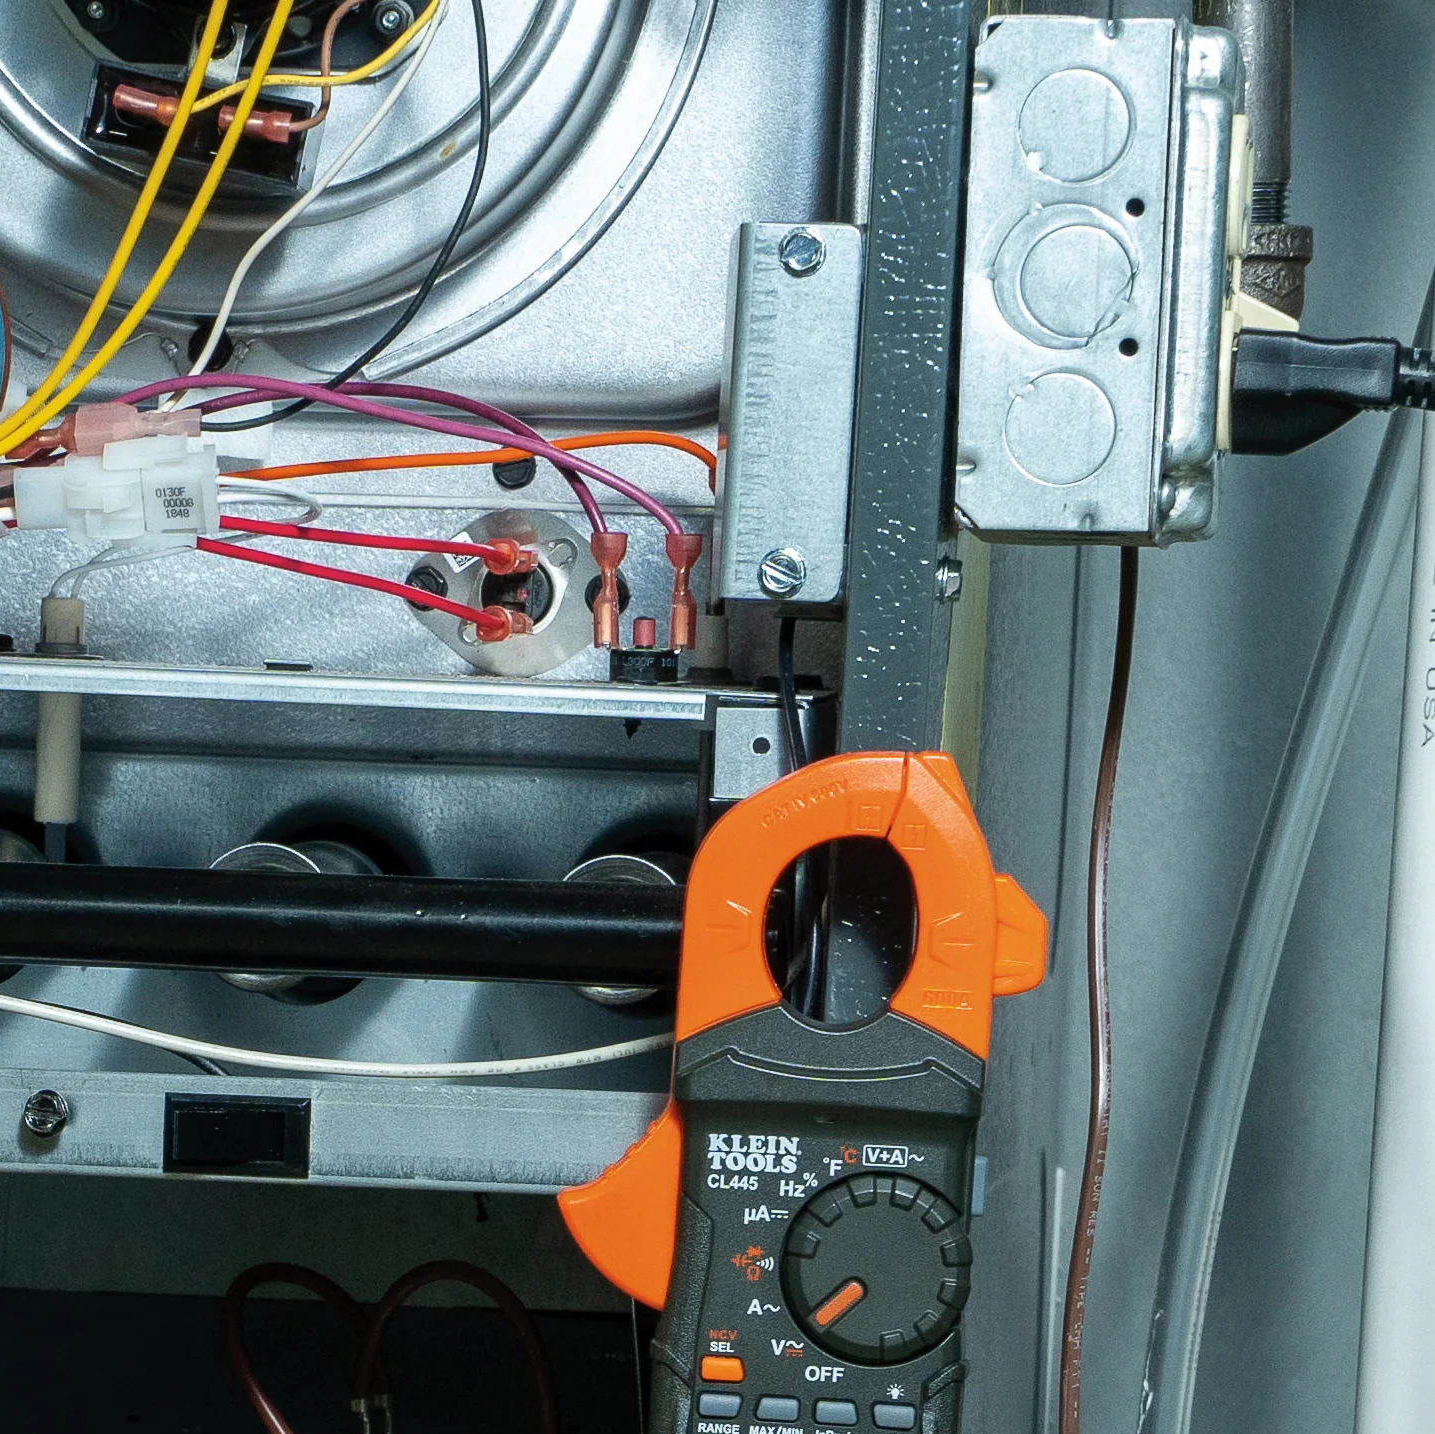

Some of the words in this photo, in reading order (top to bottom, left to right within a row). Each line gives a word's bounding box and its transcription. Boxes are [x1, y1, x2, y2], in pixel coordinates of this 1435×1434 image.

[155, 486, 186, 498] 0130F
[166, 508, 190, 519] 1848
[707, 1152, 797, 1174] TOOLS
[707, 1174, 759, 1191] CL445
[779, 1179, 805, 1197] Hz
[709, 1329, 738, 1341] NCV
[709, 1341, 734, 1352] SEL
[804, 1365, 844, 1382] OFF
[697, 1422, 740, 1434] RANGE
